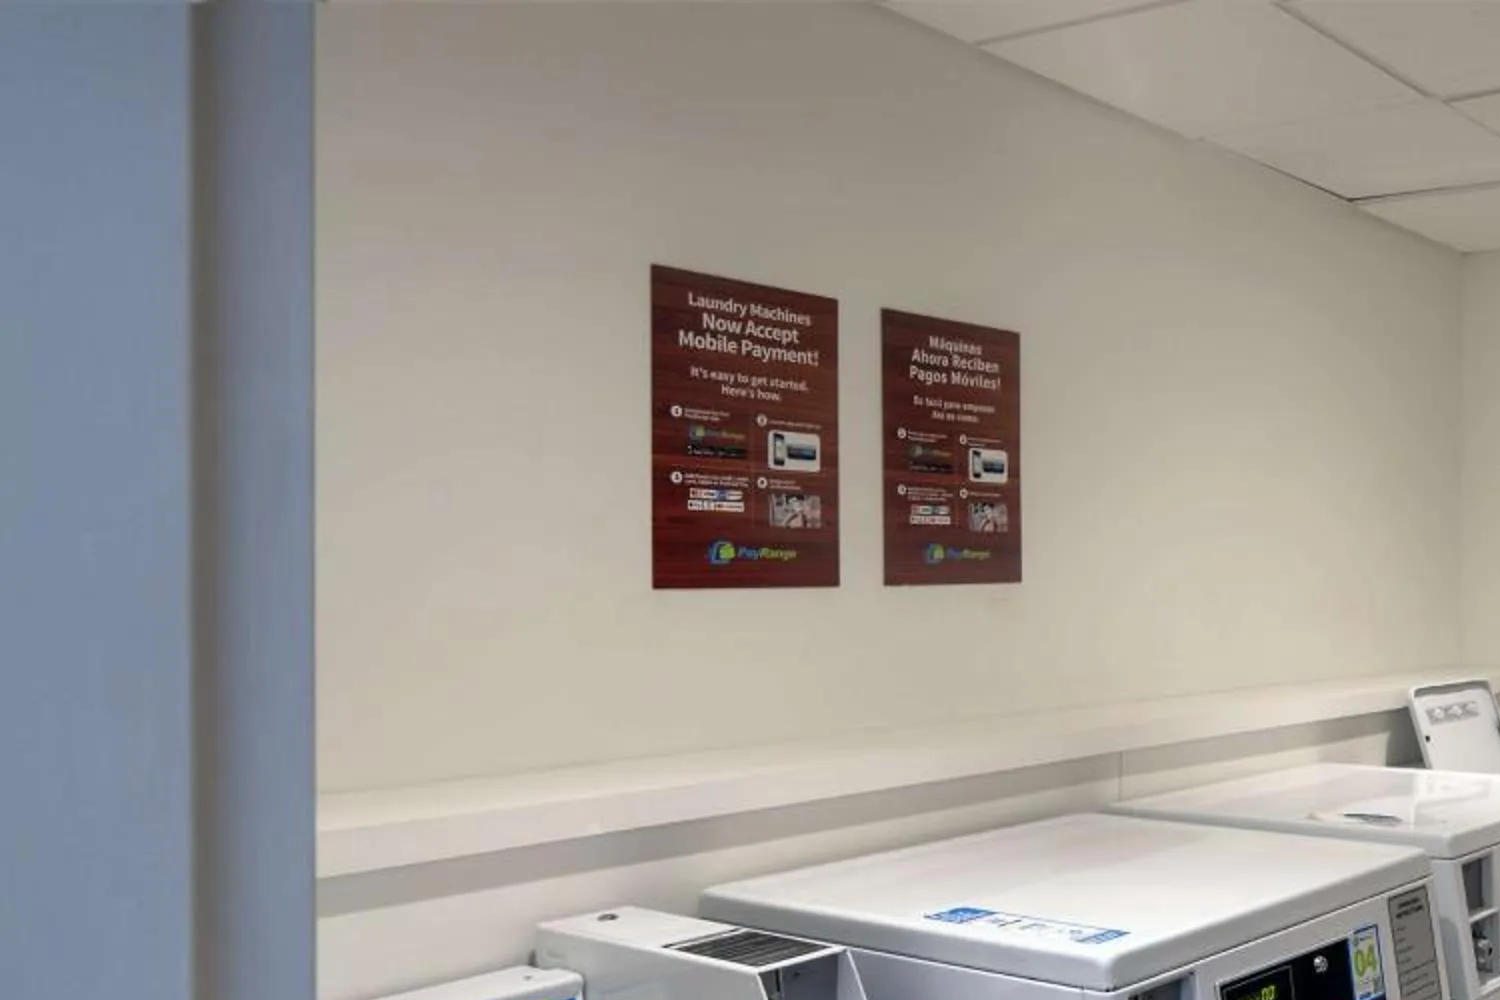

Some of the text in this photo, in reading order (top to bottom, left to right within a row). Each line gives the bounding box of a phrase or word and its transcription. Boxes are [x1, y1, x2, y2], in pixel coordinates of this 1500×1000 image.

[688, 292, 812, 327] Laundry Machines
[702, 312, 800, 345] Now Accept
[678, 329, 819, 367] Mobile Payment!
[911, 347, 999, 374] Ahora Reciben
[690, 366, 708, 379] It's
[710, 371, 735, 384] easy
[750, 376, 768, 388] get
[908, 364, 948, 385] Pagos
[721, 383, 755, 398] Here's
